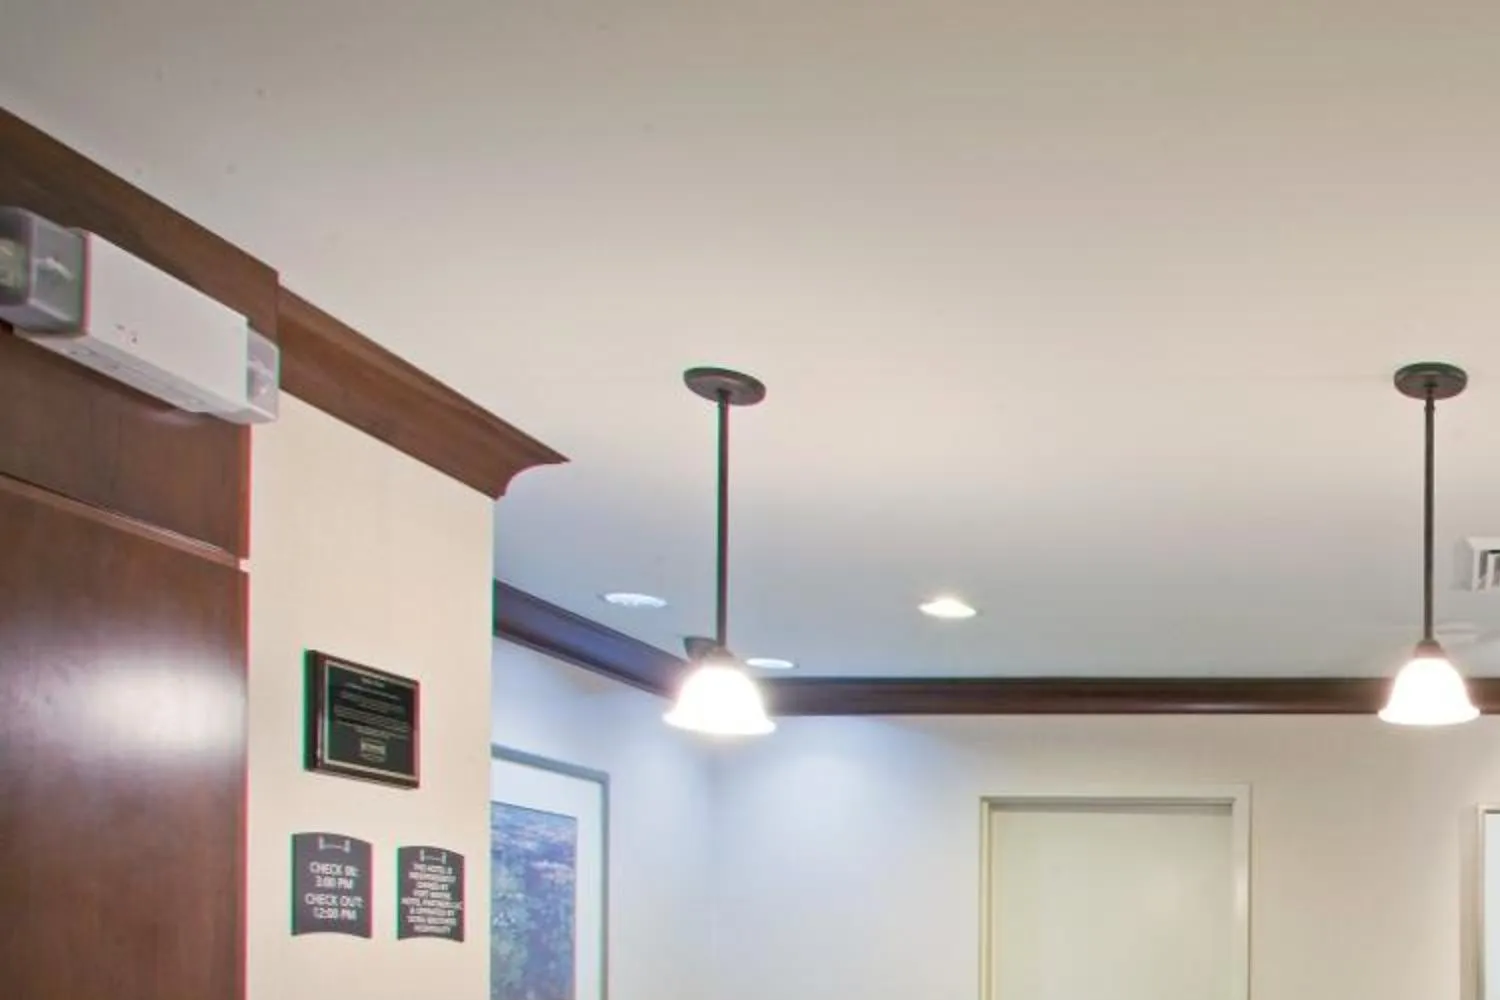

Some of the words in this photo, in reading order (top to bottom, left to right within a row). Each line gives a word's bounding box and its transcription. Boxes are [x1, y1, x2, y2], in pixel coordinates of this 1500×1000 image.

[309, 861, 343, 876] CHECK
[337, 877, 353, 890] PM
[304, 893, 340, 908] CHECK
[341, 908, 358, 921] PM
